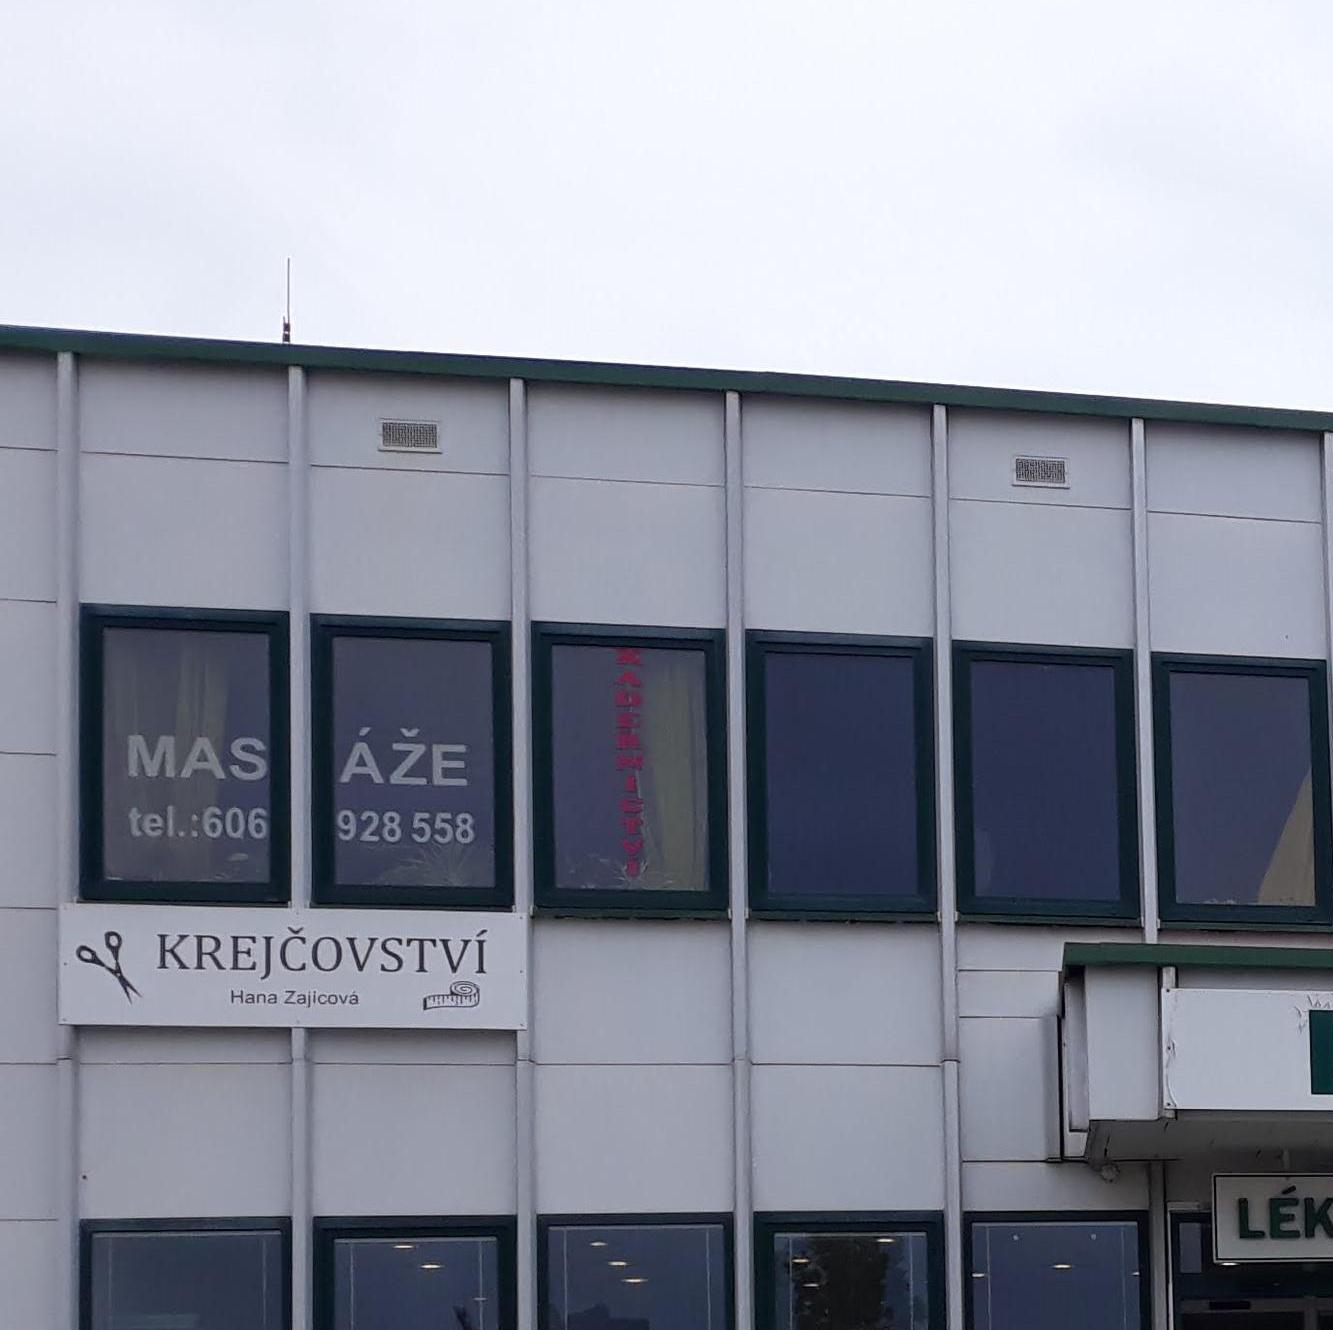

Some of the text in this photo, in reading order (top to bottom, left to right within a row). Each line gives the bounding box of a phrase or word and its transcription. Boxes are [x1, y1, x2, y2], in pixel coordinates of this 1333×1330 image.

[336, 809, 402, 842] 928
[411, 812, 475, 844] 558
[157, 927, 488, 979] KREJČOVSTVÍ
[230, 990, 278, 1005] Hana
